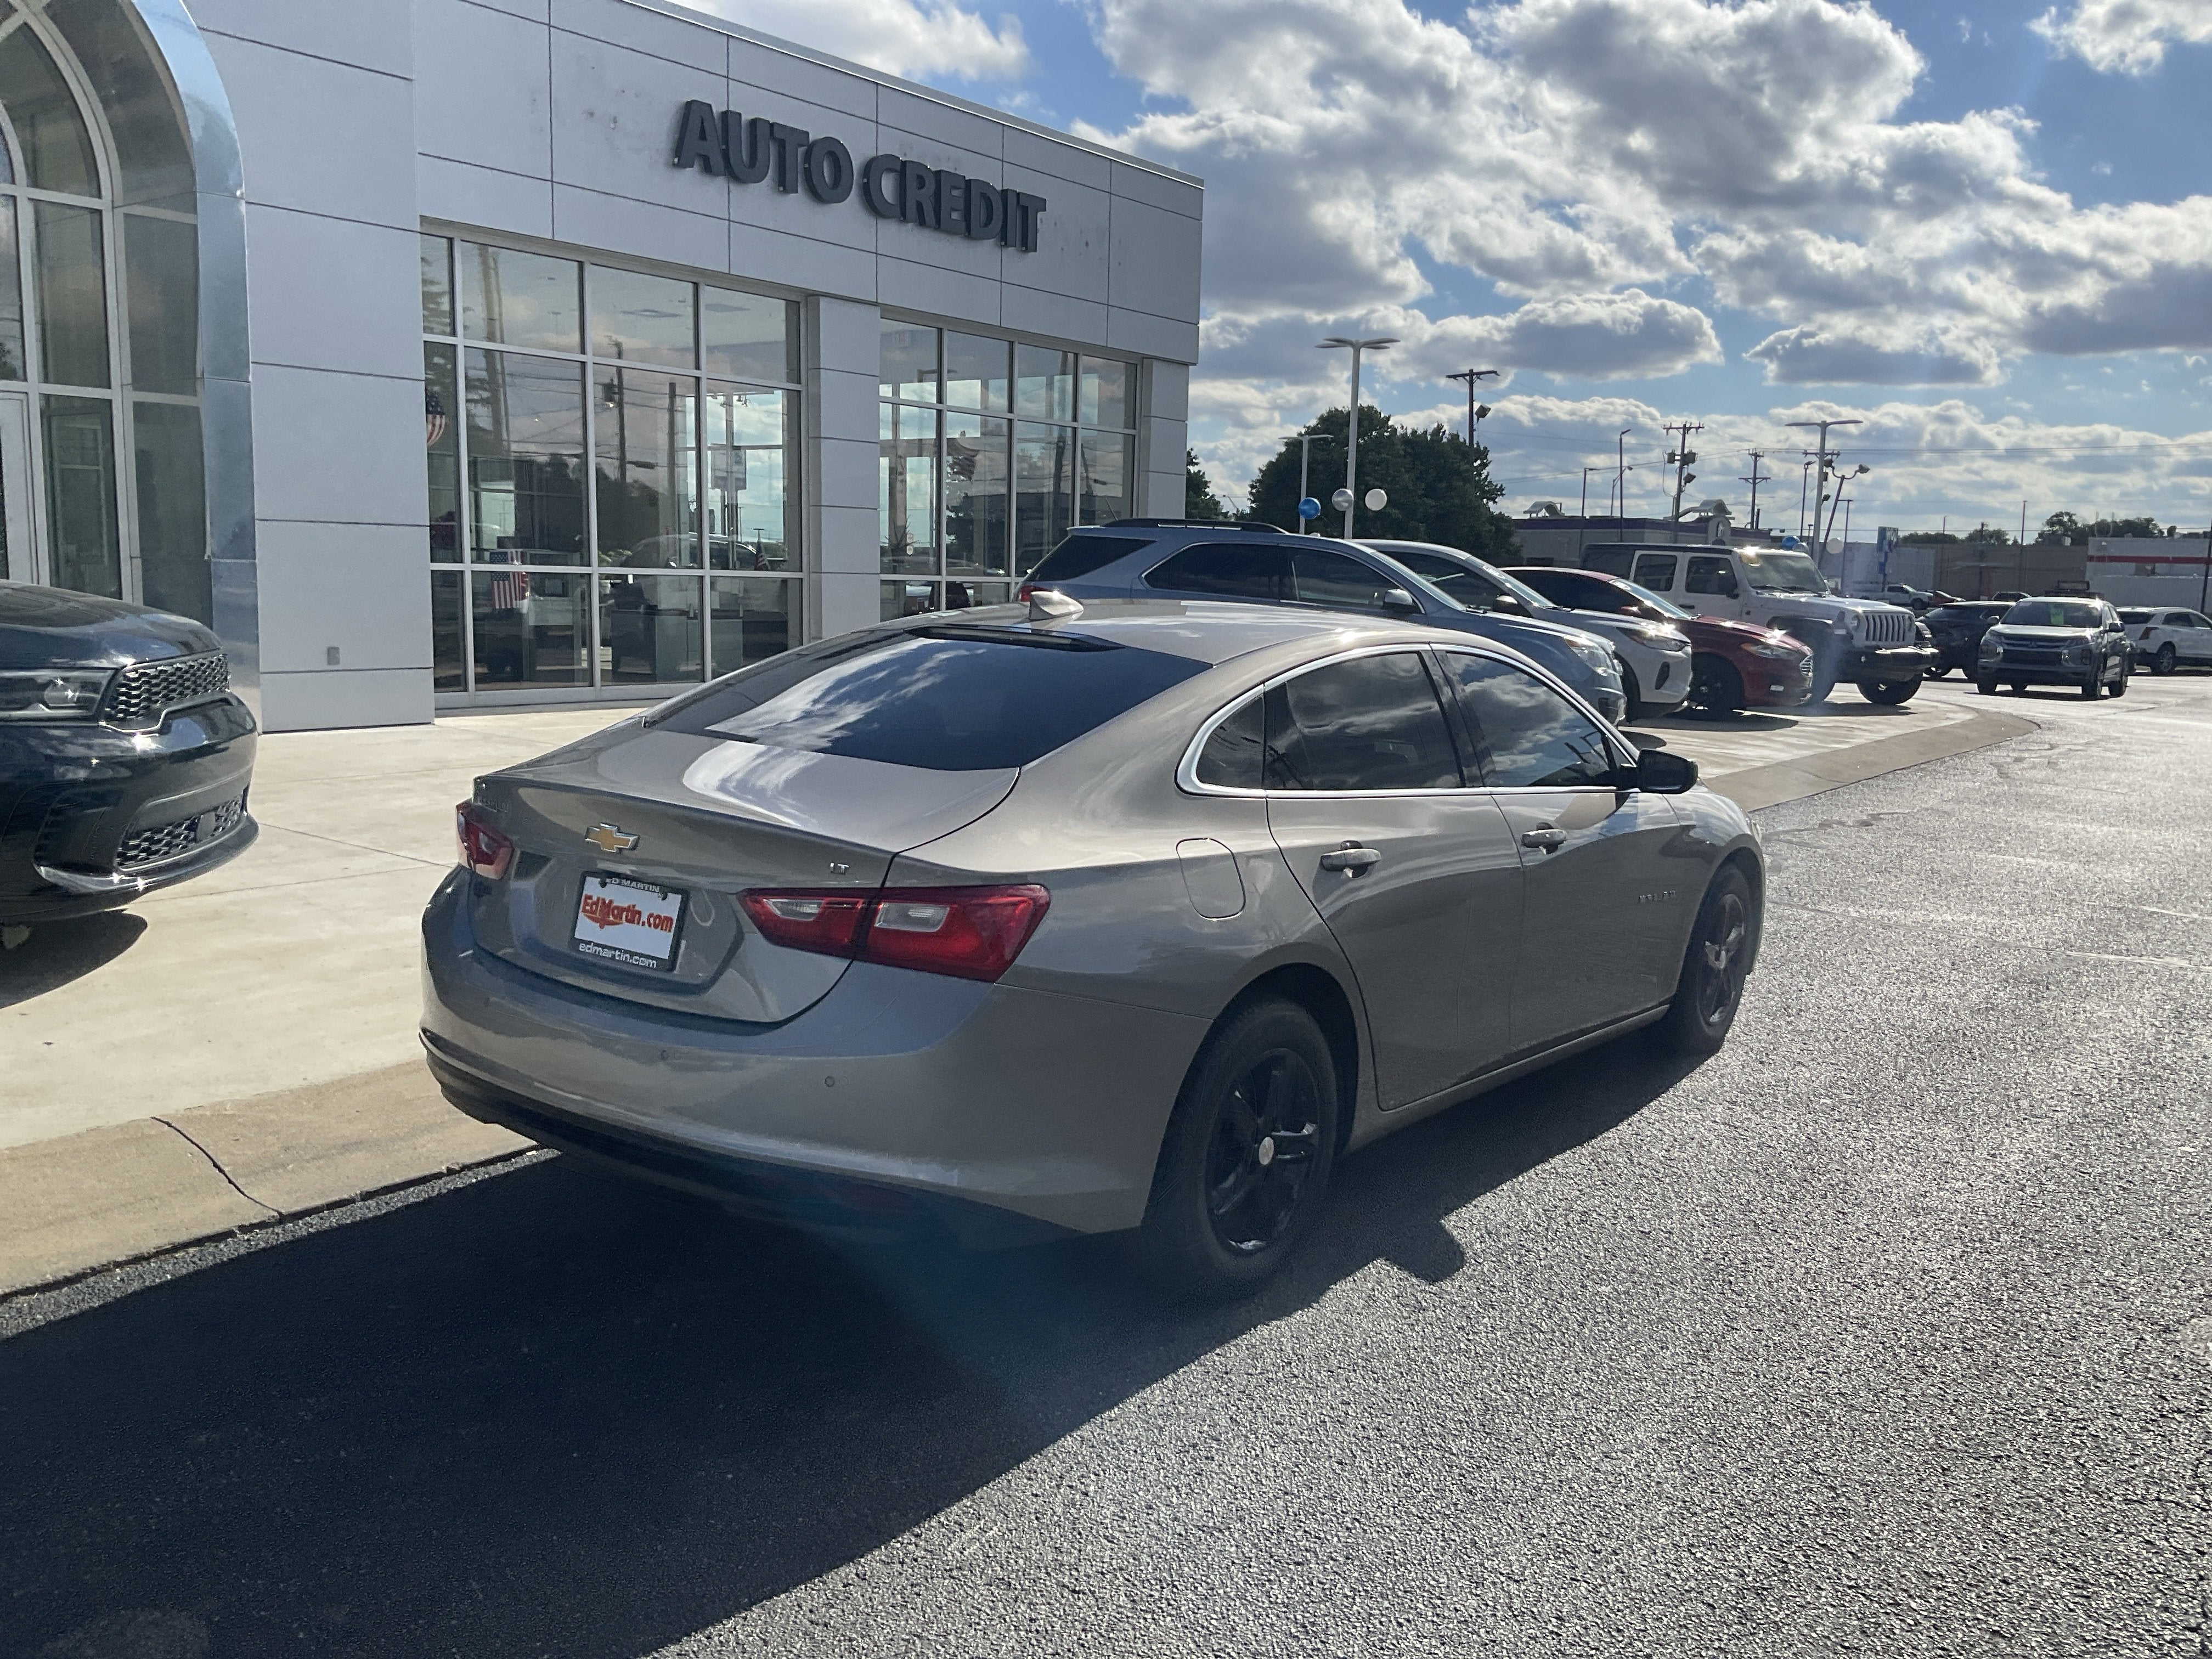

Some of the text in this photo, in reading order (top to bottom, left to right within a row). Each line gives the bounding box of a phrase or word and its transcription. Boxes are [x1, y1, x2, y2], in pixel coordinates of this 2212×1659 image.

[674, 99, 1047, 252] AUTO CREDIT
[830, 862, 850, 874] LT
[621, 879, 659, 892] MARTIN
[581, 894, 674, 933] EdMartin.com
[579, 943, 657, 968] edmartin.com
